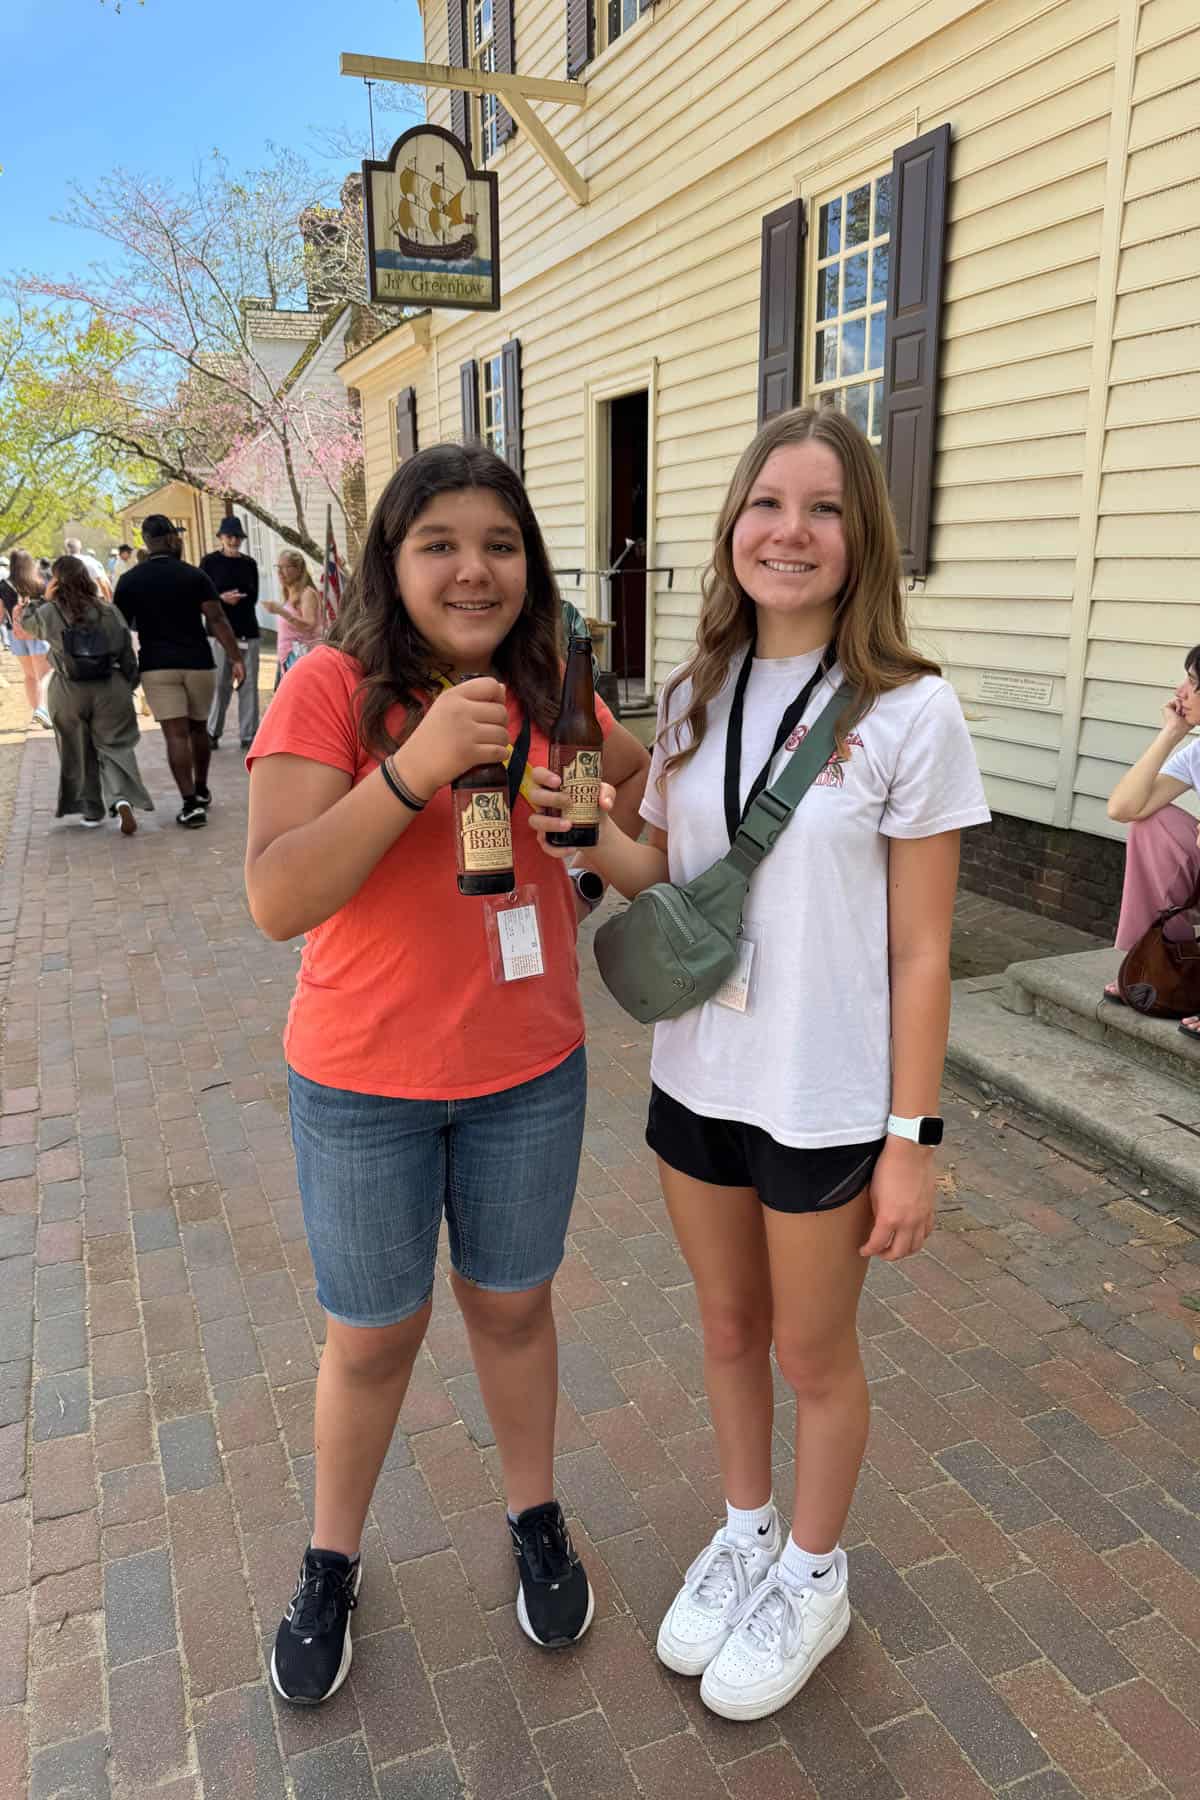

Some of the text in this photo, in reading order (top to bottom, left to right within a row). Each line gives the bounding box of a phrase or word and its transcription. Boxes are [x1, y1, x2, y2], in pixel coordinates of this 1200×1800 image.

[411, 273, 485, 297] Greenhow
[569, 784, 600, 795] ROO
[568, 794, 600, 804] BEE
[469, 827, 510, 840] ROOT
[470, 837, 510, 849] BEER
